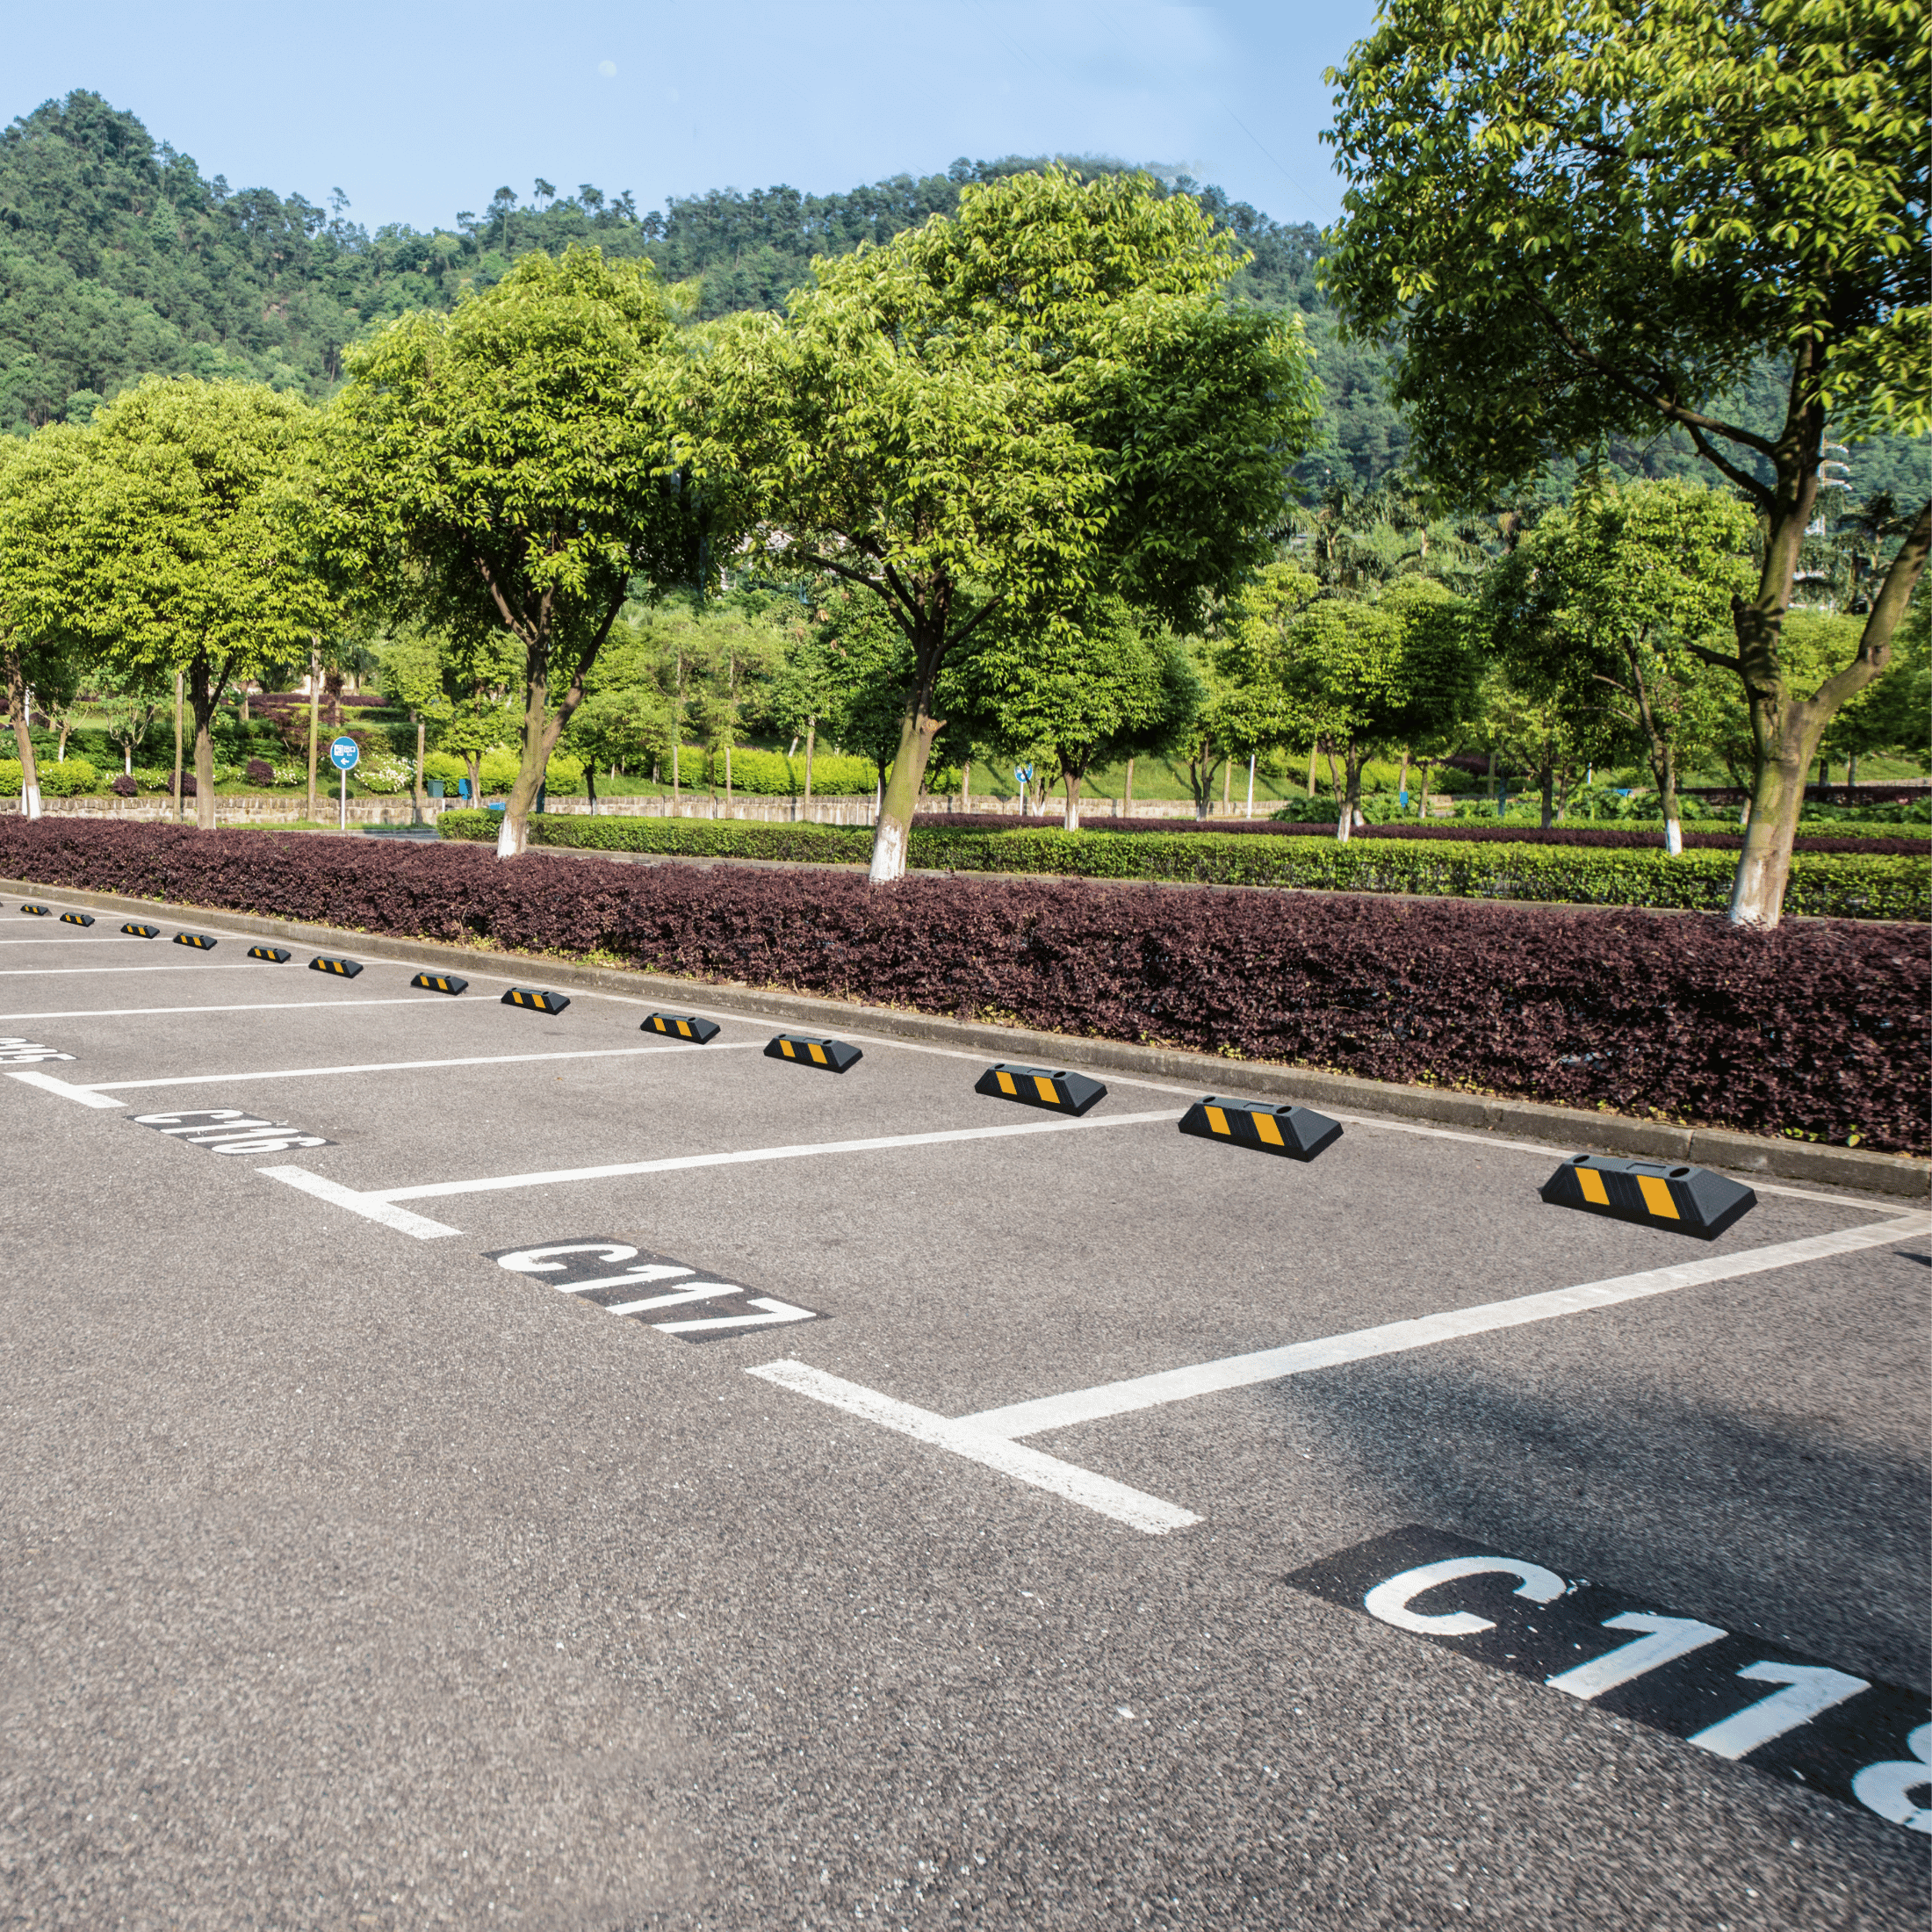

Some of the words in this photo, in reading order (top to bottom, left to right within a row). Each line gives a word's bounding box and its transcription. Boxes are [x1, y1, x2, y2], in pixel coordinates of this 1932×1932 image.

[0, 1037, 77, 1063] 115
[133, 1109, 327, 1155] C116
[498, 1244, 817, 1334] C117
